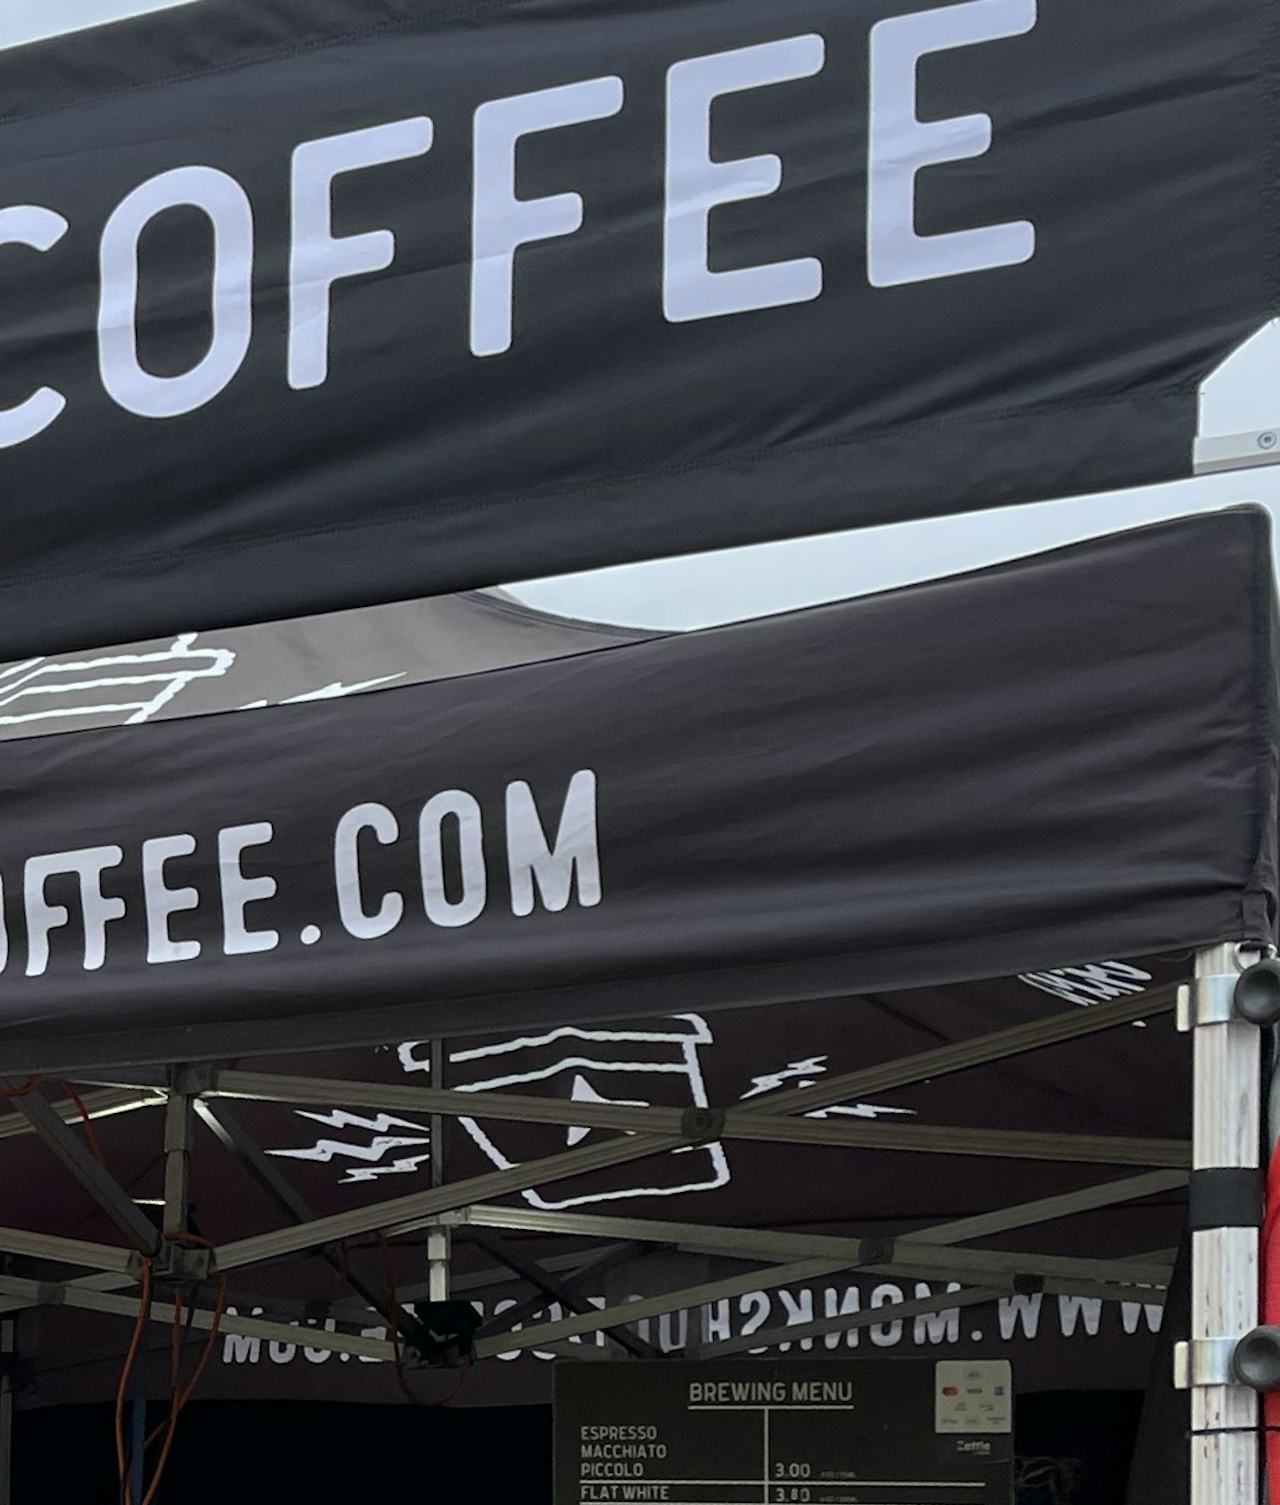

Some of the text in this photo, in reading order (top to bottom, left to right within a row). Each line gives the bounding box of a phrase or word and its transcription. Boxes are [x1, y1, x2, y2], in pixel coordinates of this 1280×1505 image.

[690, 1382, 853, 1402] BREWING MENU
[580, 1426, 658, 1440] ESPRESSO
[580, 1444, 667, 1458] MACCHIATO
[580, 1463, 644, 1477] PICCOLO
[775, 1463, 811, 1478] 3.00
[580, 1486, 618, 1500] FLAT
[623, 1486, 670, 1500] WHITE
